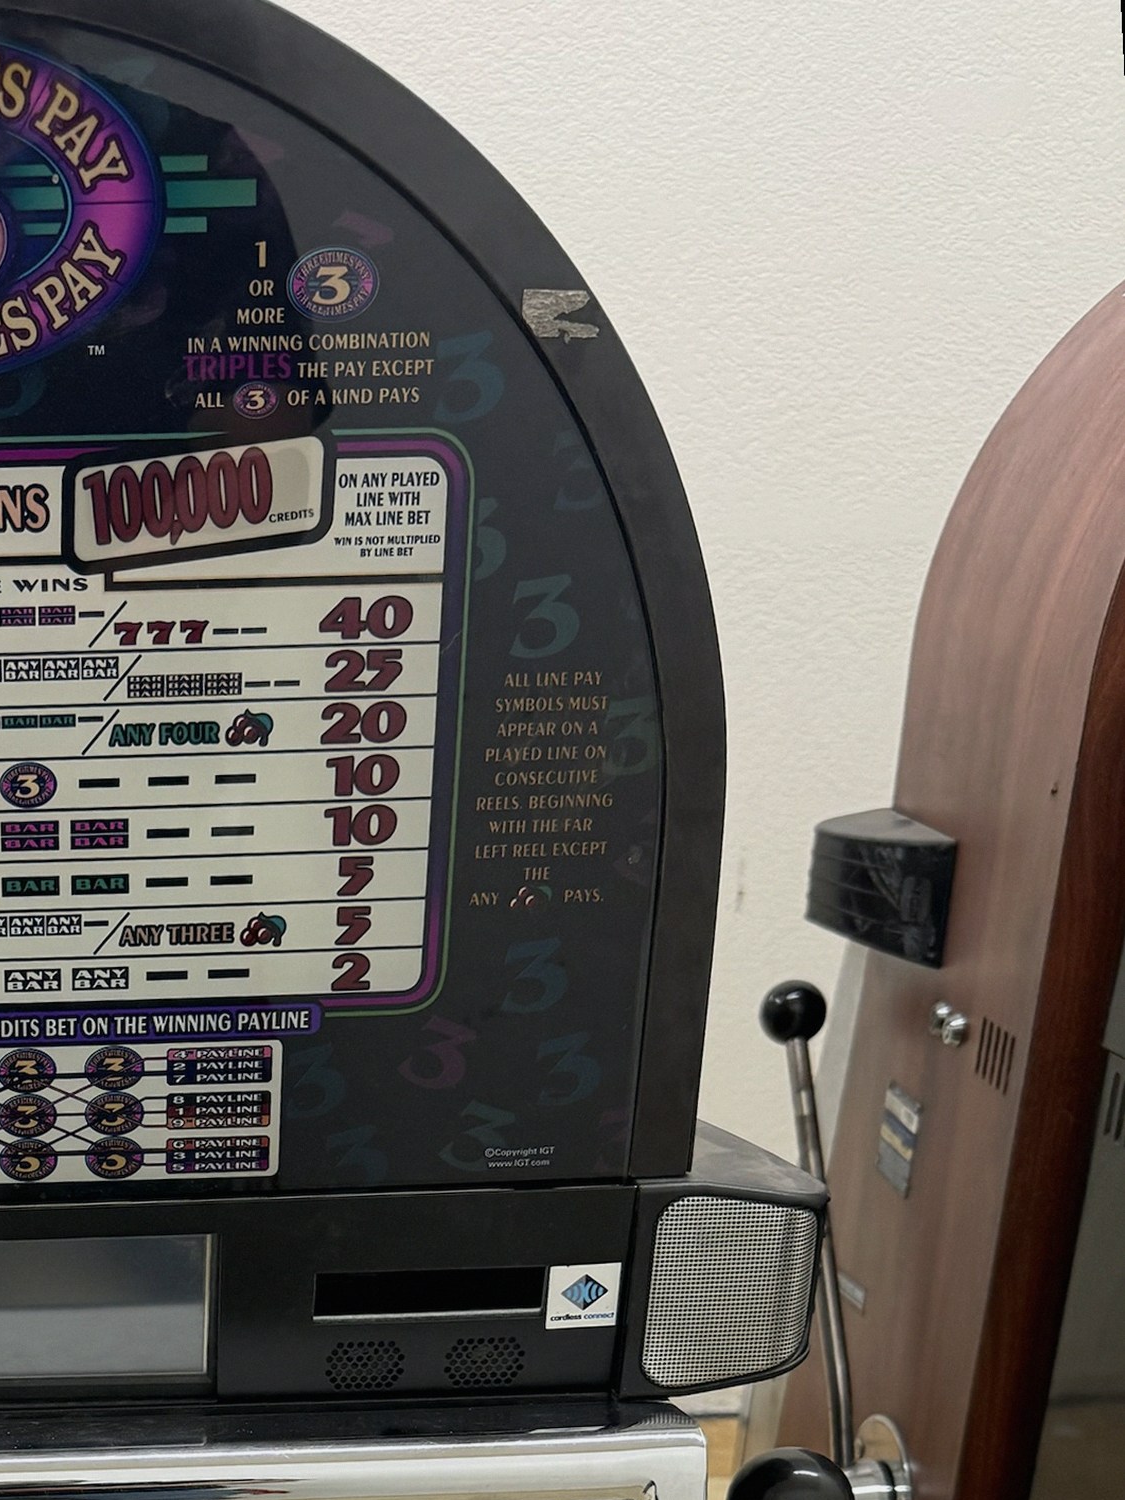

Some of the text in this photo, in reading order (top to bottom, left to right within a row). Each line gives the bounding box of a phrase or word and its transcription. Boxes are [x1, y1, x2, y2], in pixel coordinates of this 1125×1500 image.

[38, 82, 131, 195] PAY
[46, 227, 125, 329] PAY
[82, 447, 273, 546] 100,000
[268, 508, 315, 523] CREDITS
[339, 471, 440, 488] ON ANY PLAYED
[356, 491, 420, 507] LINE WITH
[345, 510, 431, 526] MAX LINE BET
[334, 534, 441, 546] WIN IS NOT MULTIPLIED
[360, 547, 413, 558] BY LINE BET
[12, 576, 89, 593] WINS
[318, 595, 414, 640] 40
[324, 649, 403, 694] 25
[109, 721, 219, 747] ANY FOUR
[320, 700, 407, 744] 20
[326, 753, 400, 797] 10
[324, 804, 398, 847] 10
[337, 856, 374, 897] 5
[119, 922, 234, 946] ANY THREE
[335, 906, 372, 946] 5
[331, 952, 371, 991] 2
[45, 1017, 77, 1037] BET
[82, 1016, 108, 1036] ON
[113, 1015, 147, 1035] THE
[152, 1013, 232, 1034] WINNING
[237, 1010, 309, 1031] PAYLINE
[550, 1312, 614, 1322] cordless connect
